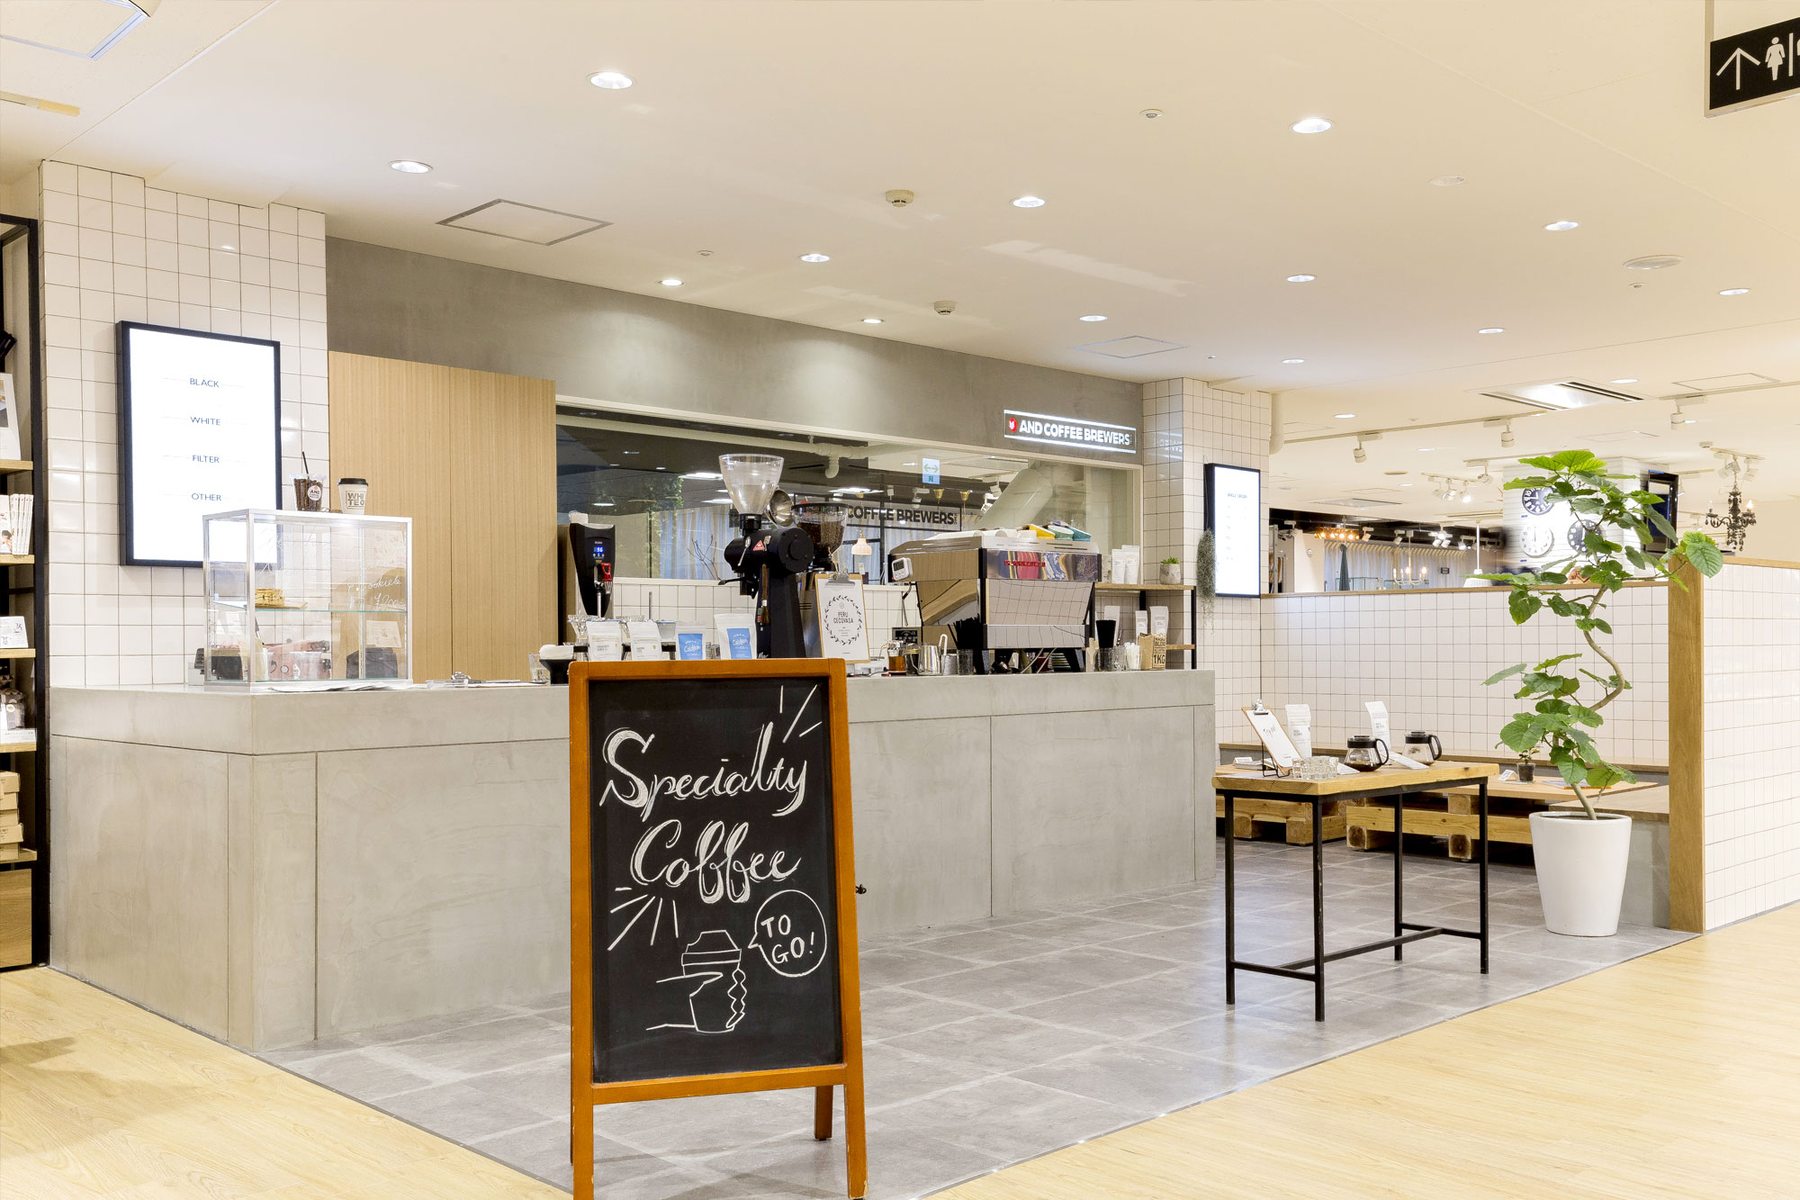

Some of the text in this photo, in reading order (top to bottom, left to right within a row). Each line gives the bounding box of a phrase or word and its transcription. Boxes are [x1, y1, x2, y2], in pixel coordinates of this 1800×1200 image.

[189, 377, 220, 388] BLACK
[190, 416, 221, 426] WHITE
[1019, 419, 1130, 446] AND COFFEE BREWERS
[192, 454, 220, 464] FILTER
[191, 492, 222, 502] OTHER
[896, 509, 955, 525] BREWERS
[599, 721, 808, 823] Specialty
[630, 818, 802, 905] Coffee
[760, 913, 792, 938] TO
[771, 931, 815, 964] GO!
